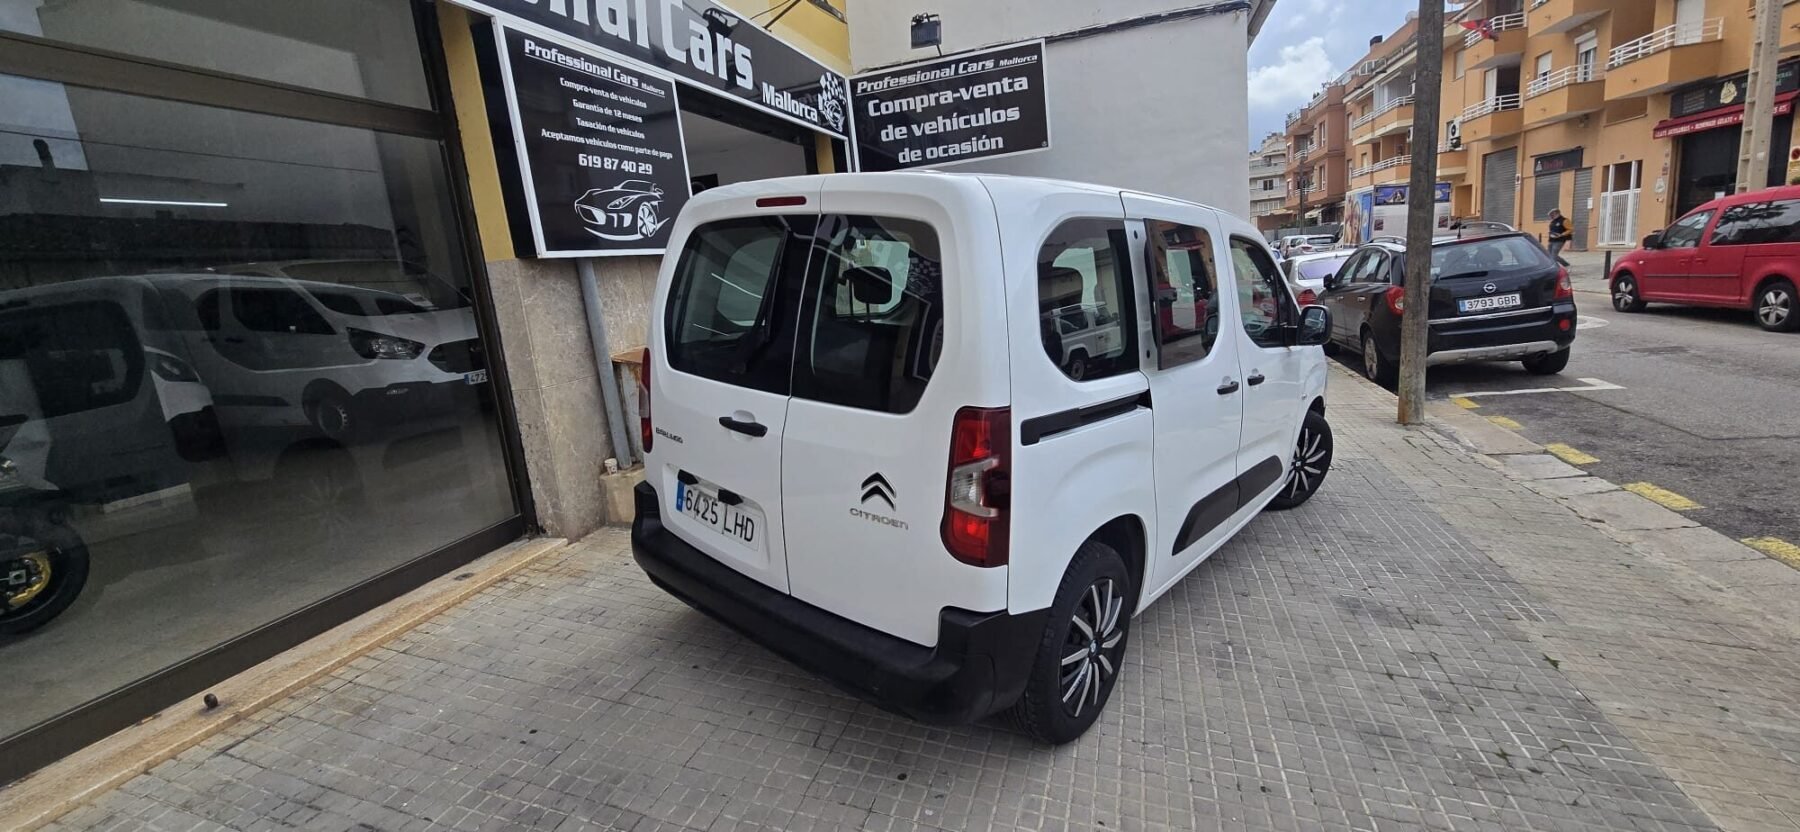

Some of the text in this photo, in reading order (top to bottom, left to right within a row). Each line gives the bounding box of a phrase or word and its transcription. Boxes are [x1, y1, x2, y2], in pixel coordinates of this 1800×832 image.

[660, 0, 754, 90] Cars
[524, 39, 665, 96] Professional Cars Mallorca
[856, 54, 1038, 95] Professional Cars Mallorca
[560, 77, 609, 98] Compra-venta
[610, 91, 618, 101] de
[761, 81, 818, 123] Mallorca
[868, 75, 1029, 117] Compra-venta
[604, 107, 613, 116] de
[614, 108, 622, 118] 12
[622, 112, 643, 124] meses
[607, 124, 616, 133] de
[881, 105, 1021, 142] de vehículos
[541, 128, 585, 144] Aceptamos
[617, 144, 635, 153] como
[635, 146, 651, 157] parte
[651, 148, 659, 157] de
[898, 135, 1004, 164] de ocasión
[578, 153, 653, 175] 619 87 40 29
[1467, 295, 1517, 310] 3793 GBR
[684, 488, 755, 543] 6425 LHD
